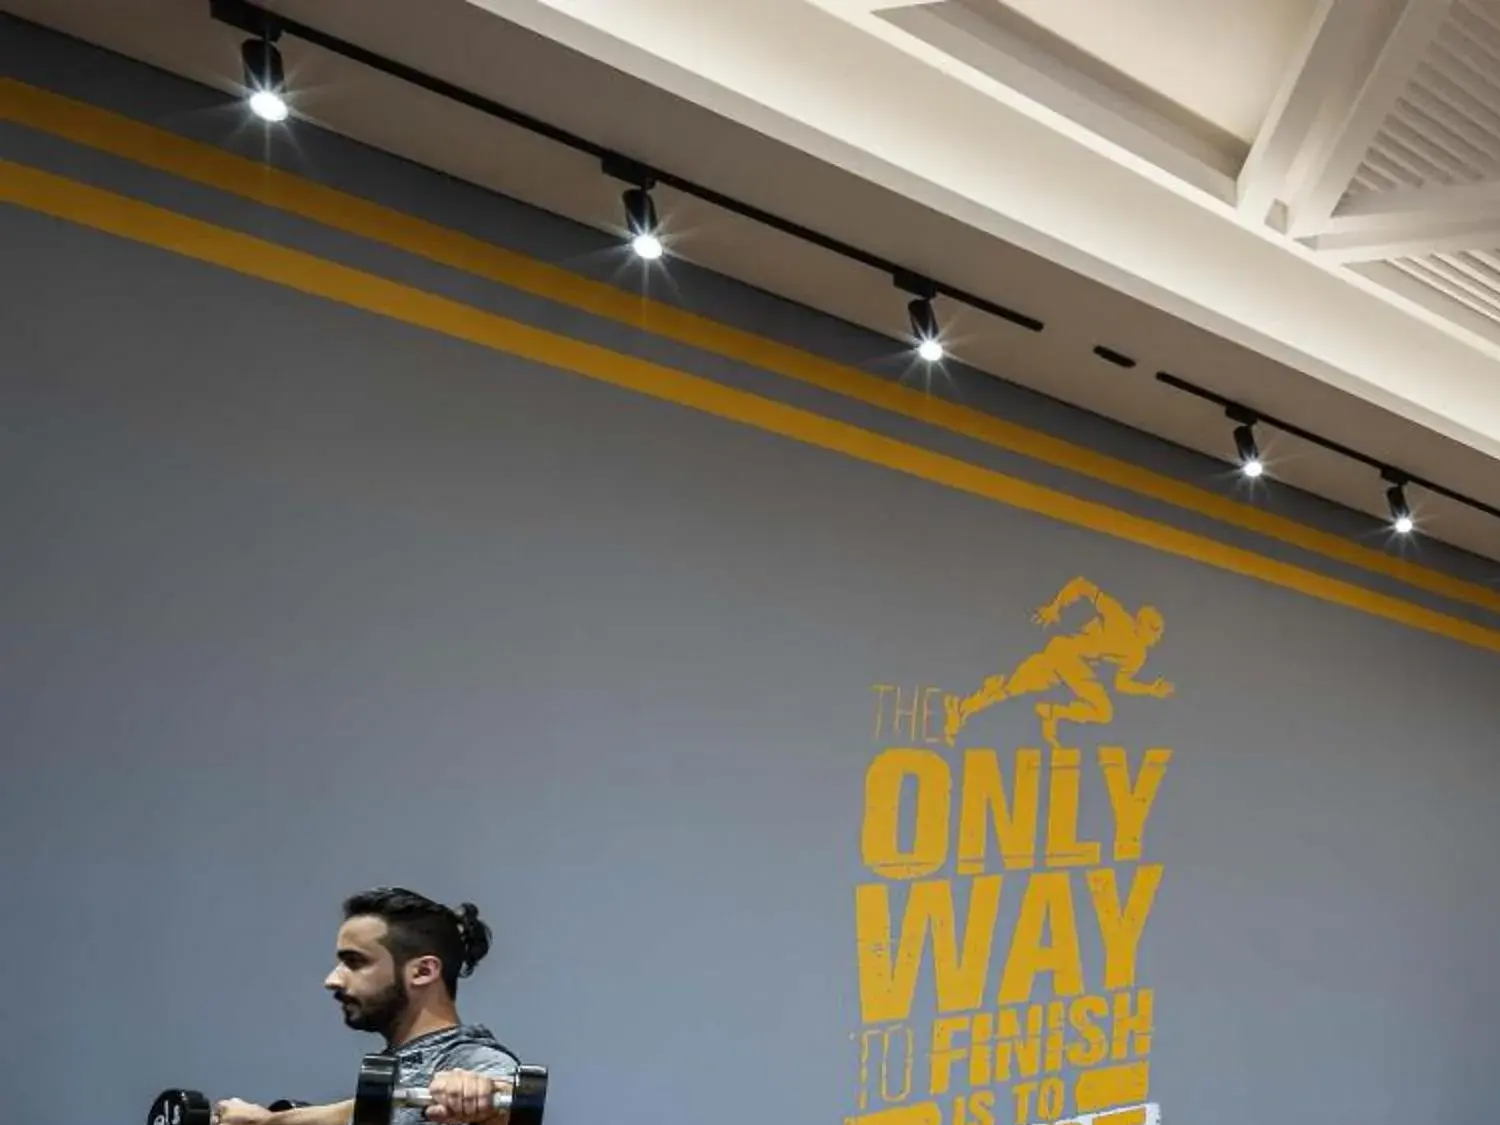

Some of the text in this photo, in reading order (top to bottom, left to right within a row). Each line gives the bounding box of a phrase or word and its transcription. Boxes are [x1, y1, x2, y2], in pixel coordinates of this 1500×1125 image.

[870, 683, 942, 744] THE
[861, 745, 1173, 880] ONLY
[855, 864, 1165, 1024] WAY
[850, 988, 1154, 1108] TO FINISH
